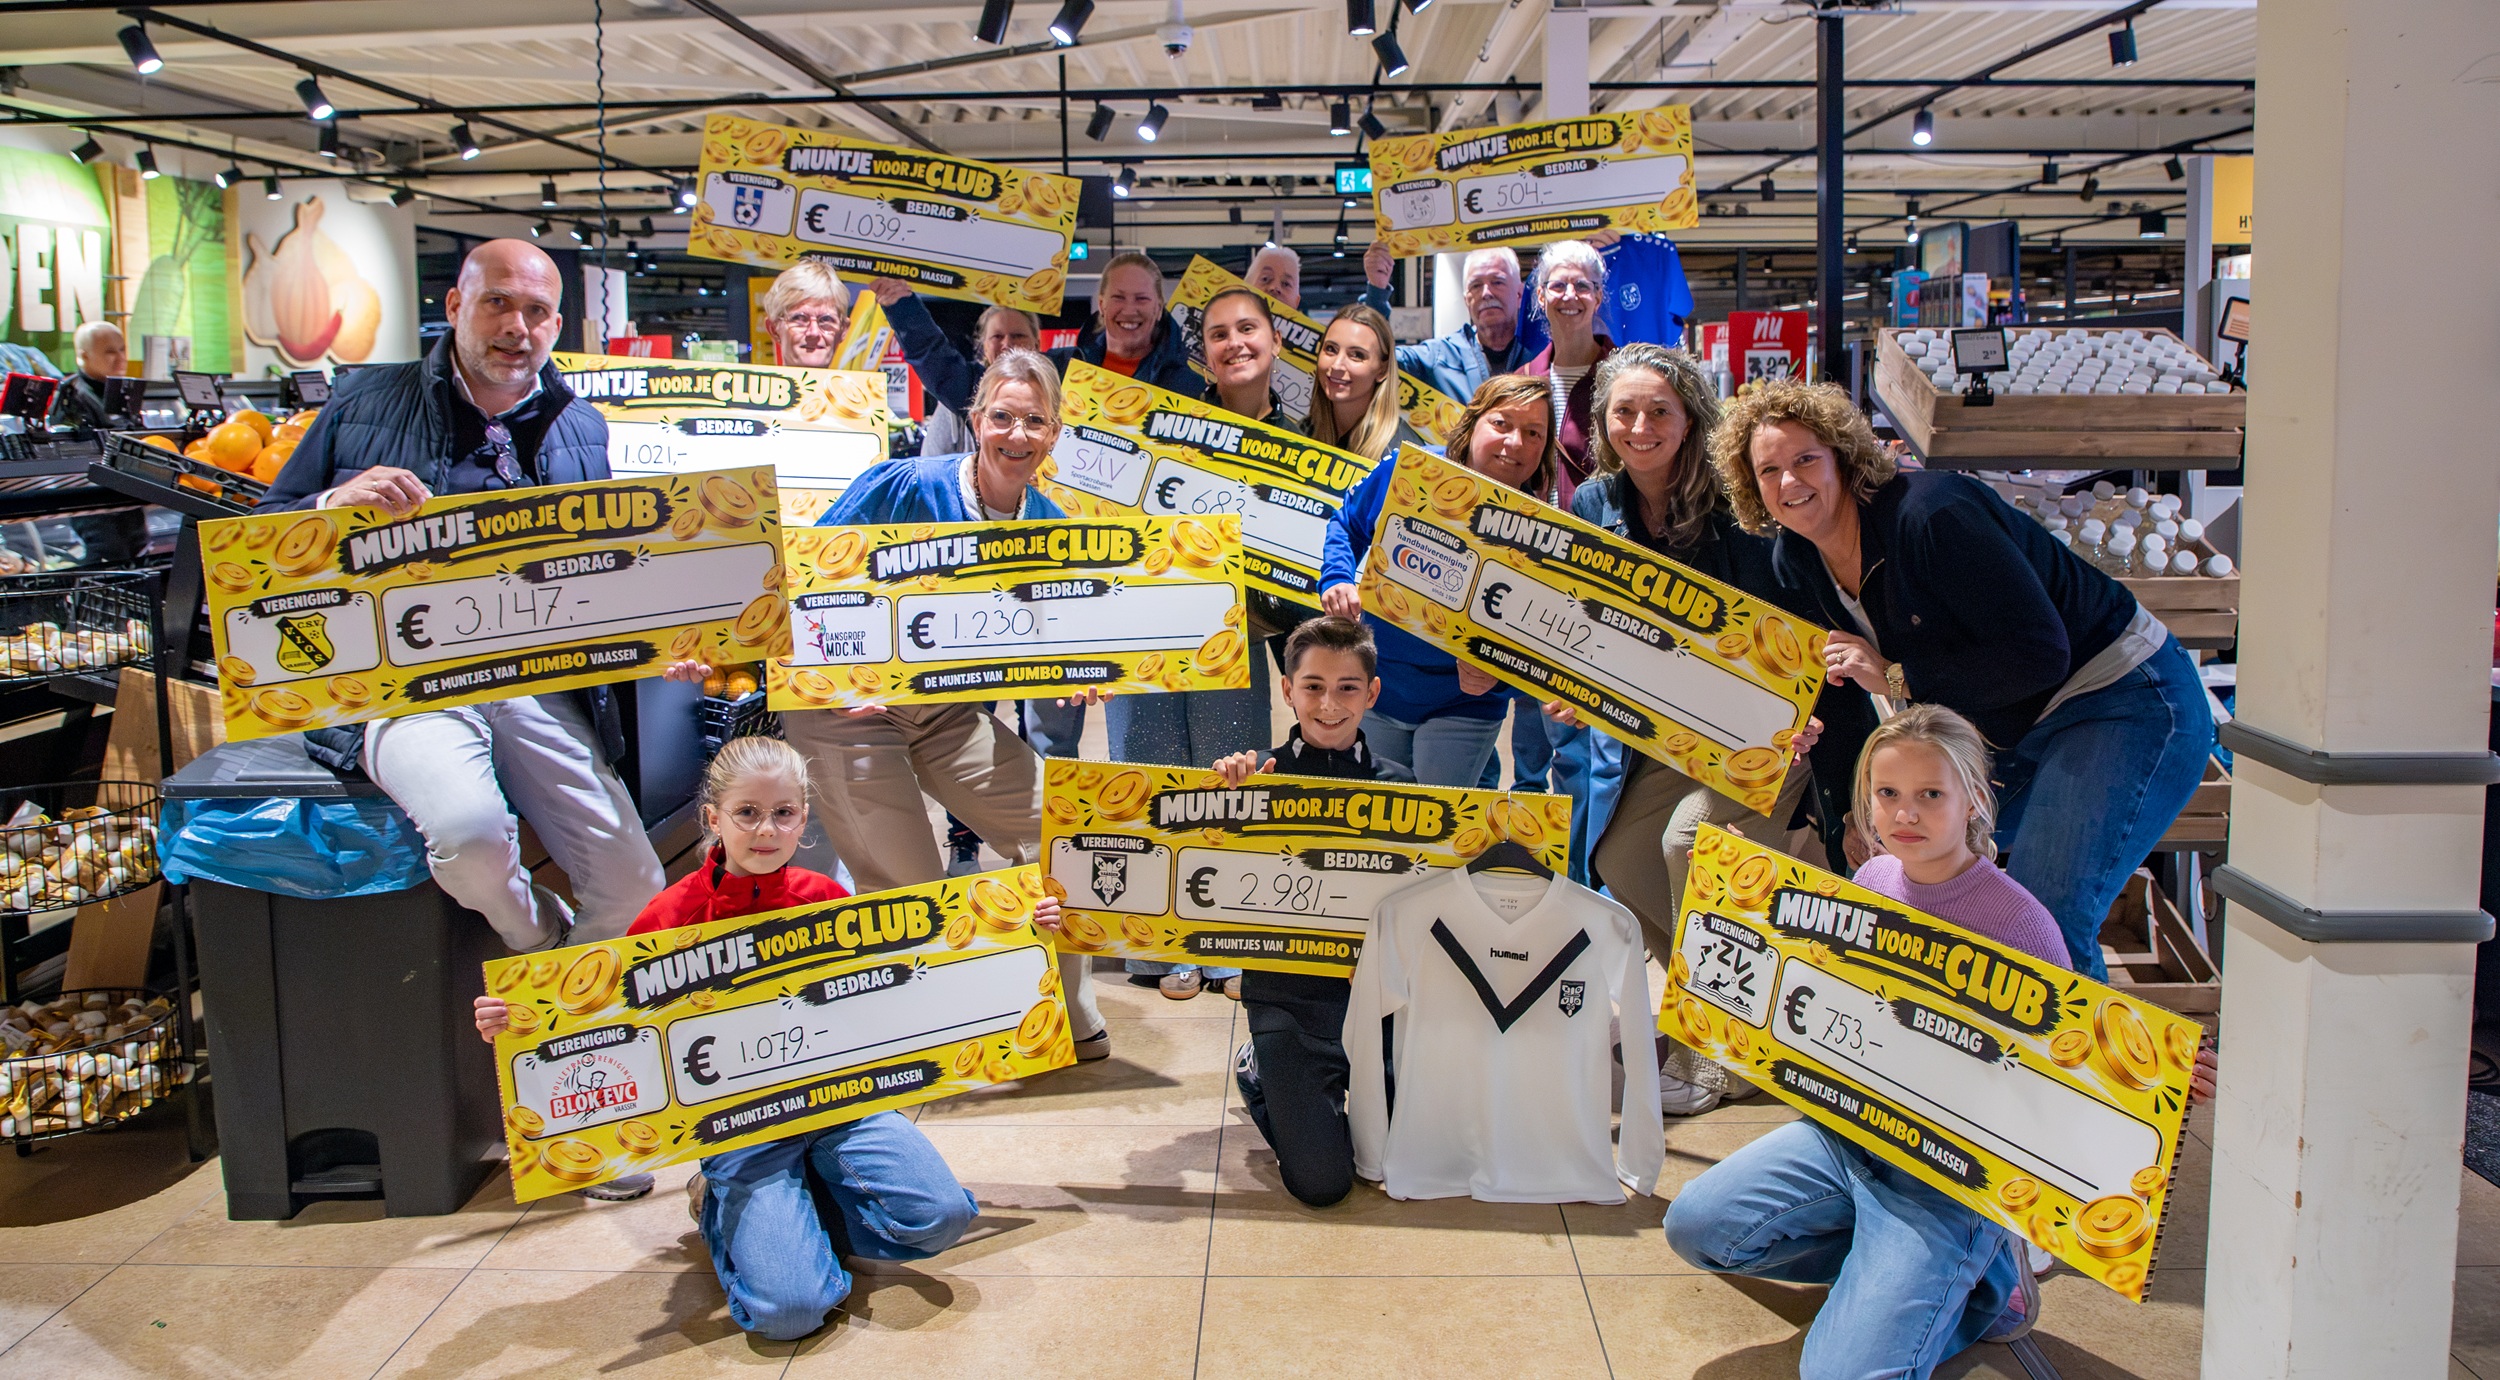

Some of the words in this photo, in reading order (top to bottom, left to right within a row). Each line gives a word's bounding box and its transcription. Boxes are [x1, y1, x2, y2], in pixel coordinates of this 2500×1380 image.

[1441, 134, 1508, 170] MUNTJE
[1508, 134, 1540, 152] VOOR
[1540, 130, 1553, 145] JE
[1554, 122, 1614, 148] CLUB
[729, 173, 778, 188] VERENIGING
[790, 149, 873, 175] MUNTJE
[873, 159, 909, 176] VOOR
[909, 163, 926, 178] JE
[926, 161, 994, 199] CLUB
[1544, 159, 1587, 176] BEDRAG
[1397, 180, 1436, 192] VERENIGING
[1463, 188, 1484, 214] €
[804, 203, 829, 233] €
[906, 201, 956, 219] BEDRAG
[1477, 232, 1486, 240] DE
[1486, 228, 1515, 239] MUNTJES
[1515, 224, 1529, 234] VAN
[1530, 219, 1569, 232] JUMBO
[1570, 218, 1599, 228] VAASSEN
[0, 224, 102, 332] EN
[856, 260, 872, 270] VAN
[873, 260, 919, 278] JUMBO
[921, 270, 953, 285] VAASSEN
[1272, 315, 1320, 353] UNTJE
[648, 377, 691, 395] VOOR
[693, 375, 712, 393] JE
[711, 371, 791, 407] CLUB
[696, 419, 754, 435] BEDRAG
[1082, 428, 1134, 452] VERENIGING
[1149, 412, 1244, 454] MUNTJE
[1241, 436, 1281, 461] VOOR
[1281, 446, 1300, 467] JE
[1155, 476, 1186, 510] €
[1269, 488, 1325, 516] BEDRAG
[350, 511, 476, 571] MUNTJE
[477, 508, 533, 539] VOOR
[534, 504, 557, 528] JE
[558, 491, 659, 532] CLUB
[1412, 520, 1461, 549] VERENIGING
[543, 552, 616, 579] BEDRAG
[876, 536, 978, 580] MUNTJE
[979, 536, 1025, 561] VOOR
[1026, 535, 1046, 555] JE
[1046, 528, 1134, 562] CLUB
[1397, 532, 1468, 572] handbalvereniging
[1272, 567, 1309, 589] VAASSEN
[1477, 508, 1574, 560] MUNTJE
[1571, 544, 1614, 573] VOOR
[1614, 558, 1635, 580] JE
[1631, 563, 1718, 629] CLUB
[261, 590, 340, 614] VERENIGING
[804, 593, 866, 608] VERENIGING
[1031, 580, 1094, 600] BEDRAG
[1481, 582, 1512, 619] €
[396, 604, 434, 650] €
[826, 631, 866, 642] DANSGROEP
[907, 611, 936, 650] €
[1600, 606, 1660, 644] BEDRAG
[826, 641, 867, 657] MDC.NL
[422, 680, 439, 694] DE
[441, 669, 492, 692] MUNTJES
[493, 664, 517, 681] VAN
[519, 651, 587, 677] JUMBO
[589, 648, 638, 665] VAASSEN
[924, 676, 938, 689] DE
[938, 672, 982, 687] MUNTJES
[984, 670, 1003, 682] VAN
[1004, 665, 1063, 683] JUMBO
[1065, 667, 1107, 679] VAASSEN
[1479, 643, 1491, 656] DE
[1491, 648, 1529, 673] MUNTJES
[1530, 664, 1548, 682] VAN
[1547, 673, 1601, 708] JUMBO
[1602, 701, 1641, 730] VAASSEN
[1159, 790, 1270, 826] MUNTJE
[1271, 799, 1322, 819] VOOR
[1324, 799, 1345, 819] JE
[1346, 793, 1444, 837] CLUB
[1081, 836, 1145, 850] VERENIGING
[1324, 852, 1393, 870] BEDRAG
[1185, 866, 1218, 908] €
[1200, 937, 1212, 949] DE
[1215, 938, 1260, 951] MUNTJES
[1263, 940, 1284, 952] VAN
[1286, 939, 1349, 958] JUMBO
[1710, 916, 1760, 948] VERENIGING
[633, 933, 757, 1004] MUNTJE
[756, 930, 811, 961] VOOR
[812, 920, 835, 947] JE
[834, 900, 932, 949] CLUB
[1490, 947, 1528, 961] hummel
[1776, 892, 1878, 949] MUNTJE
[1876, 927, 1923, 962] VOOR
[1924, 941, 1948, 970] JE
[1944, 943, 2048, 1027] CLUB
[823, 967, 894, 1000] BEDRAG
[1784, 985, 1816, 1036] €
[548, 1027, 627, 1057] VERENIGING
[1912, 1007, 1983, 1053] BEDRAG
[683, 1035, 721, 1086] €
[614, 1102, 637, 1113] VAASSEN
[712, 1120, 729, 1134] DE
[730, 1104, 781, 1129] MUNTJES
[782, 1095, 805, 1113] VAN
[807, 1076, 874, 1108] JUMBO
[876, 1068, 924, 1090] VAASSEN
[1784, 1068, 1798, 1085] DE
[1798, 1074, 1839, 1104] MUNTJES
[1839, 1093, 1860, 1115] VAN
[1859, 1102, 1921, 1148] JUMBO
[1922, 1138, 1969, 1177] VAASSEN
